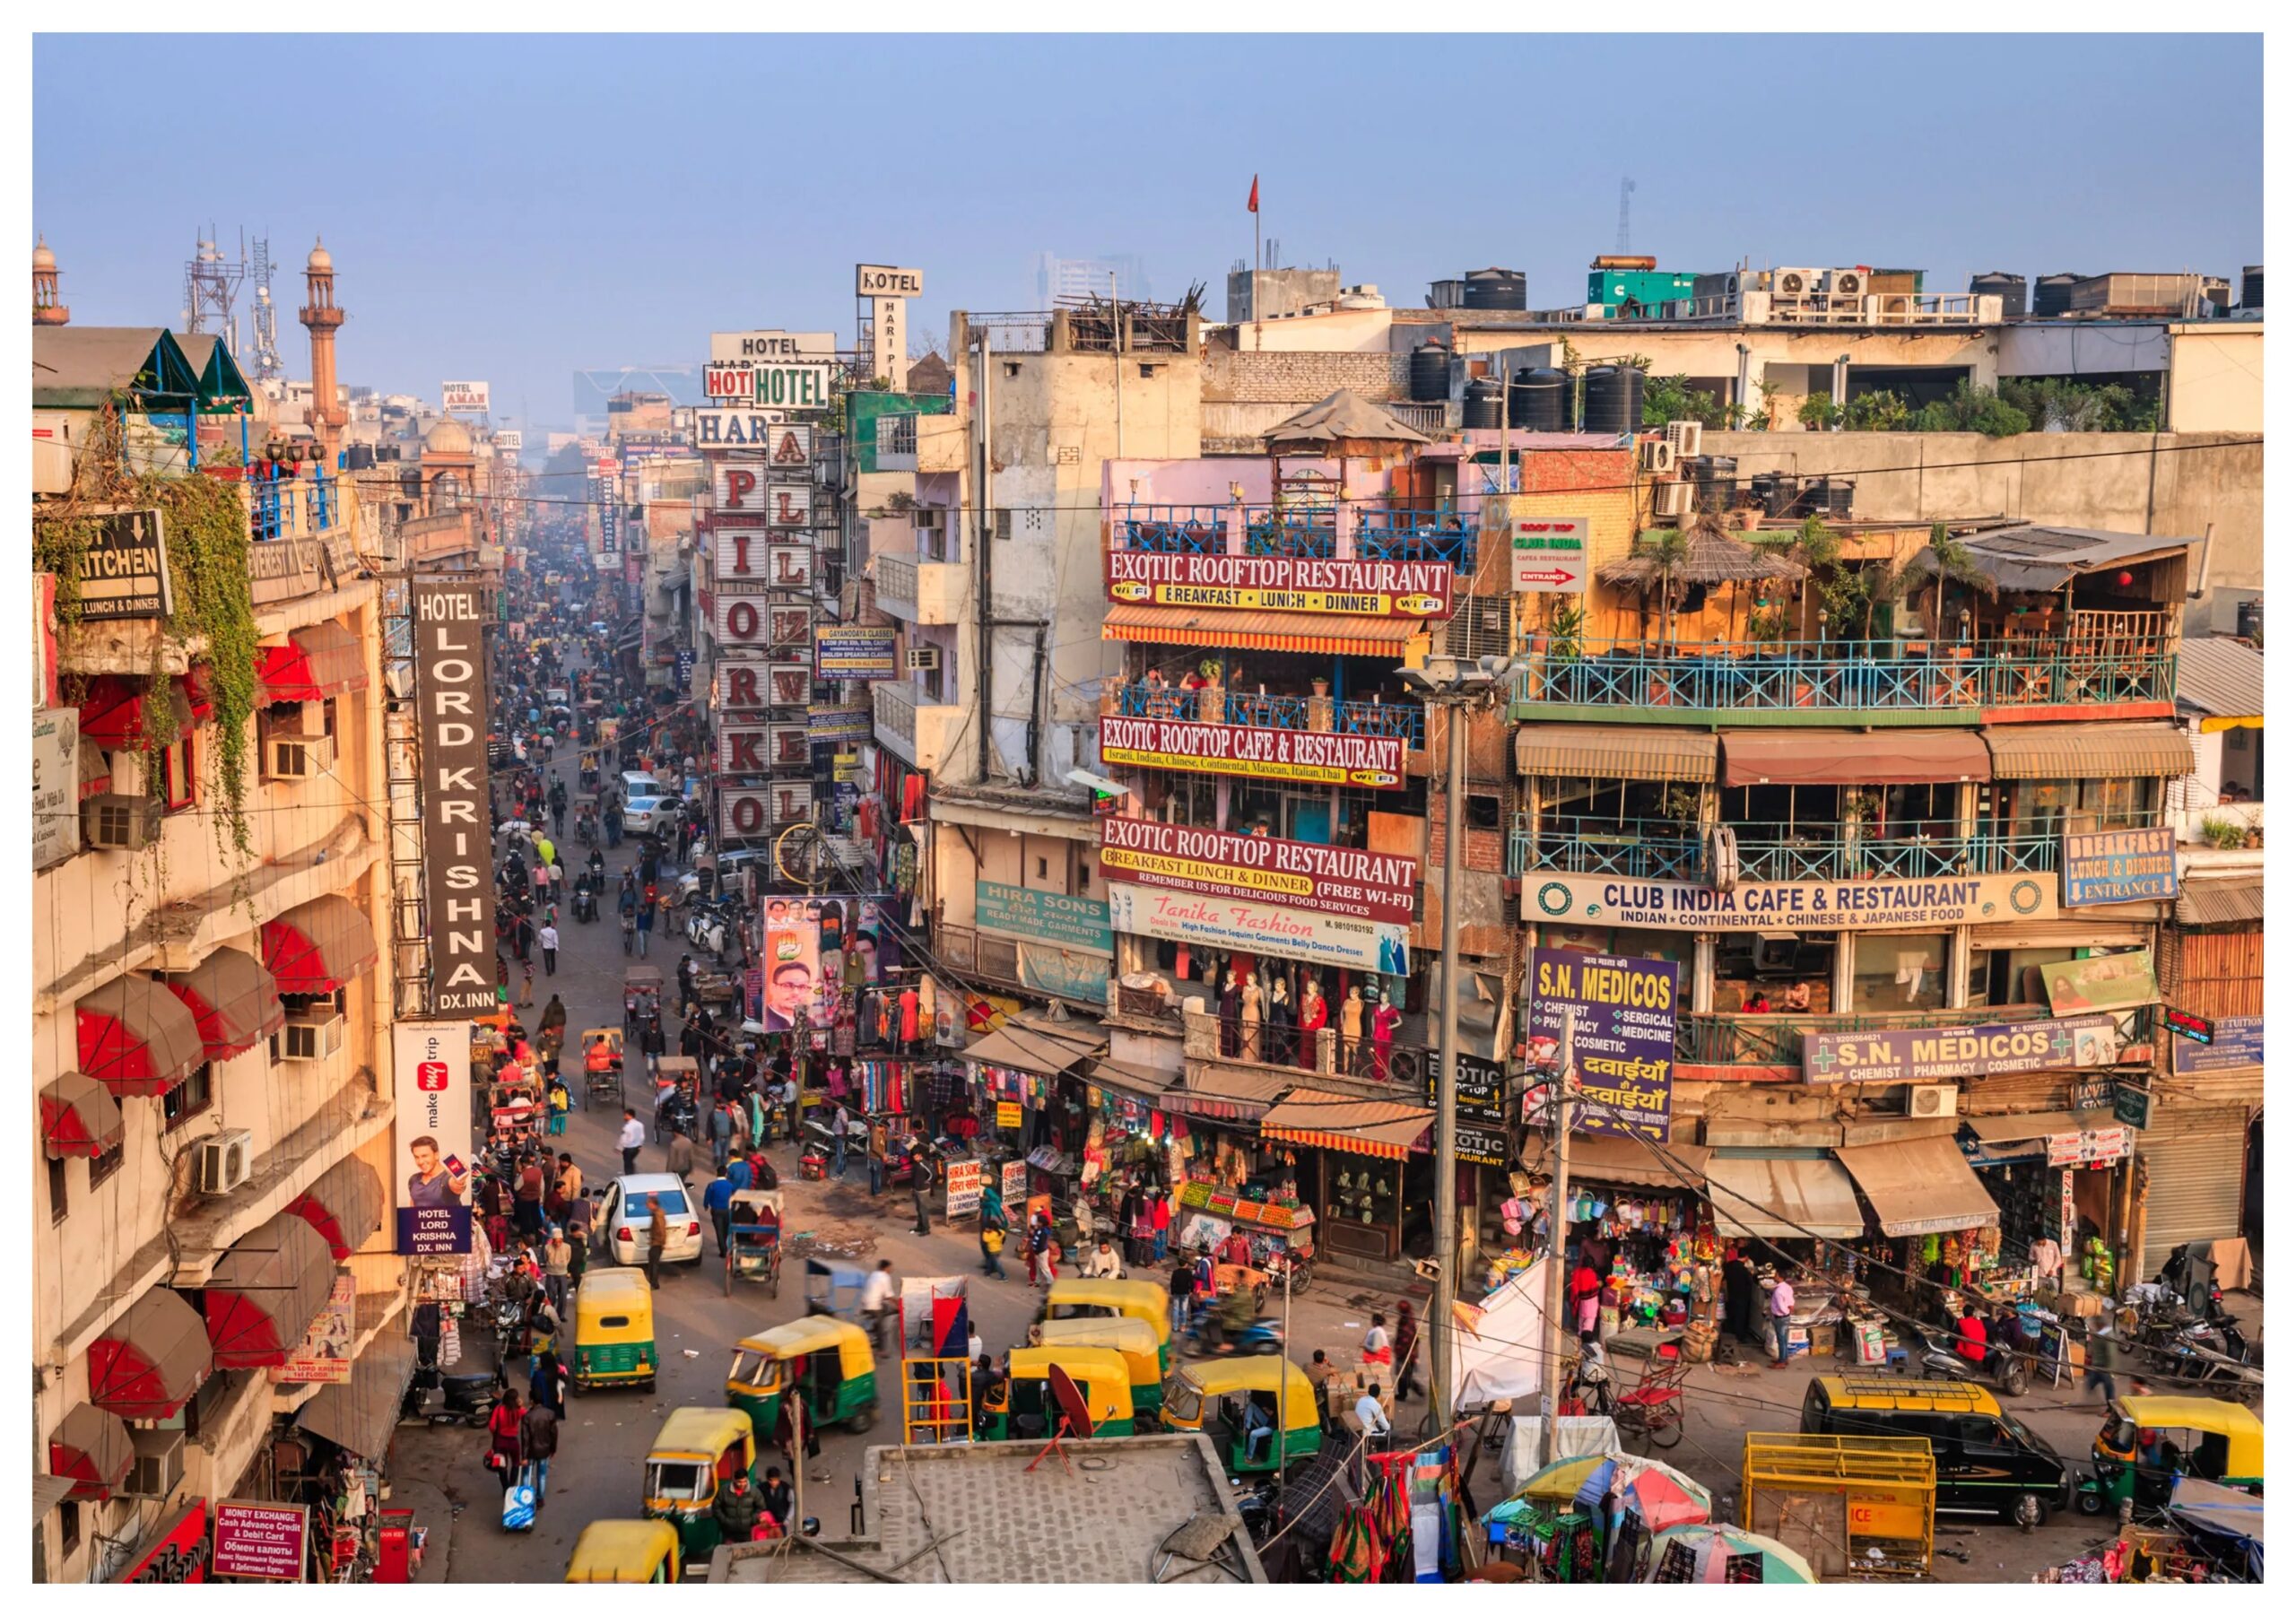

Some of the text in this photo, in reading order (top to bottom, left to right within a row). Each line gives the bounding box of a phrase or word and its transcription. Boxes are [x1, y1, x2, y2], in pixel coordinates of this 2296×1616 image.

[864, 272, 920, 291] HOTEL
[884, 301, 895, 348] HARI
[743, 338, 801, 355] HOTEL
[444, 384, 472, 392] HOTEL
[709, 371, 754, 395] HOT
[755, 368, 827, 405] HOTEL
[448, 394, 485, 404] AMAN
[699, 414, 781, 445] HAR
[1514, 538, 1582, 550] CLUB INDIA
[1110, 553, 1447, 592] EXOTIC ROOFTOP RESTAURANT
[84, 600, 115, 613] LUNCH
[117, 600, 125, 612] &
[420, 594, 479, 621] HOTEL
[1261, 591, 1306, 609] LUNCH
[1325, 595, 1379, 613] DINNER
[867, 630, 892, 638] CLASSES
[432, 628, 474, 747] LORD
[1103, 719, 1399, 770] EXOTIC ROOFTOP CAFE & RESTAURANT
[1109, 750, 1135, 761] Israeli,
[1136, 752, 1163, 764] Indian,
[1165, 755, 1198, 768] Chinese,
[1200, 757, 1249, 772] Continental,
[1252, 762, 1290, 776] Maxican,
[1105, 819, 1416, 888] EXOTIC ROOFTOP RESTAURANT
[2069, 830, 2170, 858] BREAKFAST
[439, 767, 486, 987] KRISHNA
[1105, 850, 1309, 892] BREAKFAST LUNCH & DINNER
[2070, 856, 2171, 880] LUNCH & DINNER
[1138, 872, 1370, 916] REMEMBER US FOR DELICIOUS FOOD SERVICES
[1317, 881, 1413, 911] (FREE WI-FI)
[1605, 882, 1980, 912] CLUB INDIA CAFE & RESTAURANT
[2085, 880, 2161, 899] ENTRANCE
[988, 886, 1101, 917] HIRA SONS
[987, 909, 1101, 938] READY MADE GARMENTS
[1153, 895, 1313, 937] Tanika Fashion
[1325, 920, 1333, 928] M.
[1622, 908, 1964, 926] INDIAN CONTINENTAL CHINESE & JAPANESE FOOD
[1181, 922, 1198, 932] High
[1200, 925, 1227, 936] Fashion
[1228, 927, 1254, 940] Sequins
[1256, 933, 1290, 945] Garments
[1292, 938, 1310, 950] Belly
[1312, 941, 1335, 952] Dance
[1336, 945, 1363, 957] Dresses
[1539, 962, 1671, 1011] S.N. MEDICOS
[1544, 1002, 1588, 1017] CHEMIST
[1544, 1017, 1599, 1032] PHAMACY
[1622, 1012, 1674, 1028] SERGICAL
[1622, 1026, 1671, 1042] MEDICINE
[1575, 1036, 1626, 1053] COSMETIC
[1839, 1031, 2049, 1066] S.N. MEDICOS
[1849, 1057, 2040, 1080] CHEMIST PHARMACY COSMETIC
[1483, 1109, 1501, 1118] OPEN
[1455, 1152, 1504, 1166] TAURANT
[1456, 1146, 1488, 1156] OOFTOP
[418, 1210, 451, 1219] HOTEL
[421, 1221, 448, 1229] LORD
[413, 1232, 457, 1241] KRISHNA
[417, 1243, 452, 1252] DX. INN
[225, 1508, 296, 1522] MONEY EXCHANGE
[219, 1518, 300, 1532] Cash Advance Credit
[234, 1529, 284, 1541] & Debit Card
[224, 1542, 292, 1556] Обмен валюты
